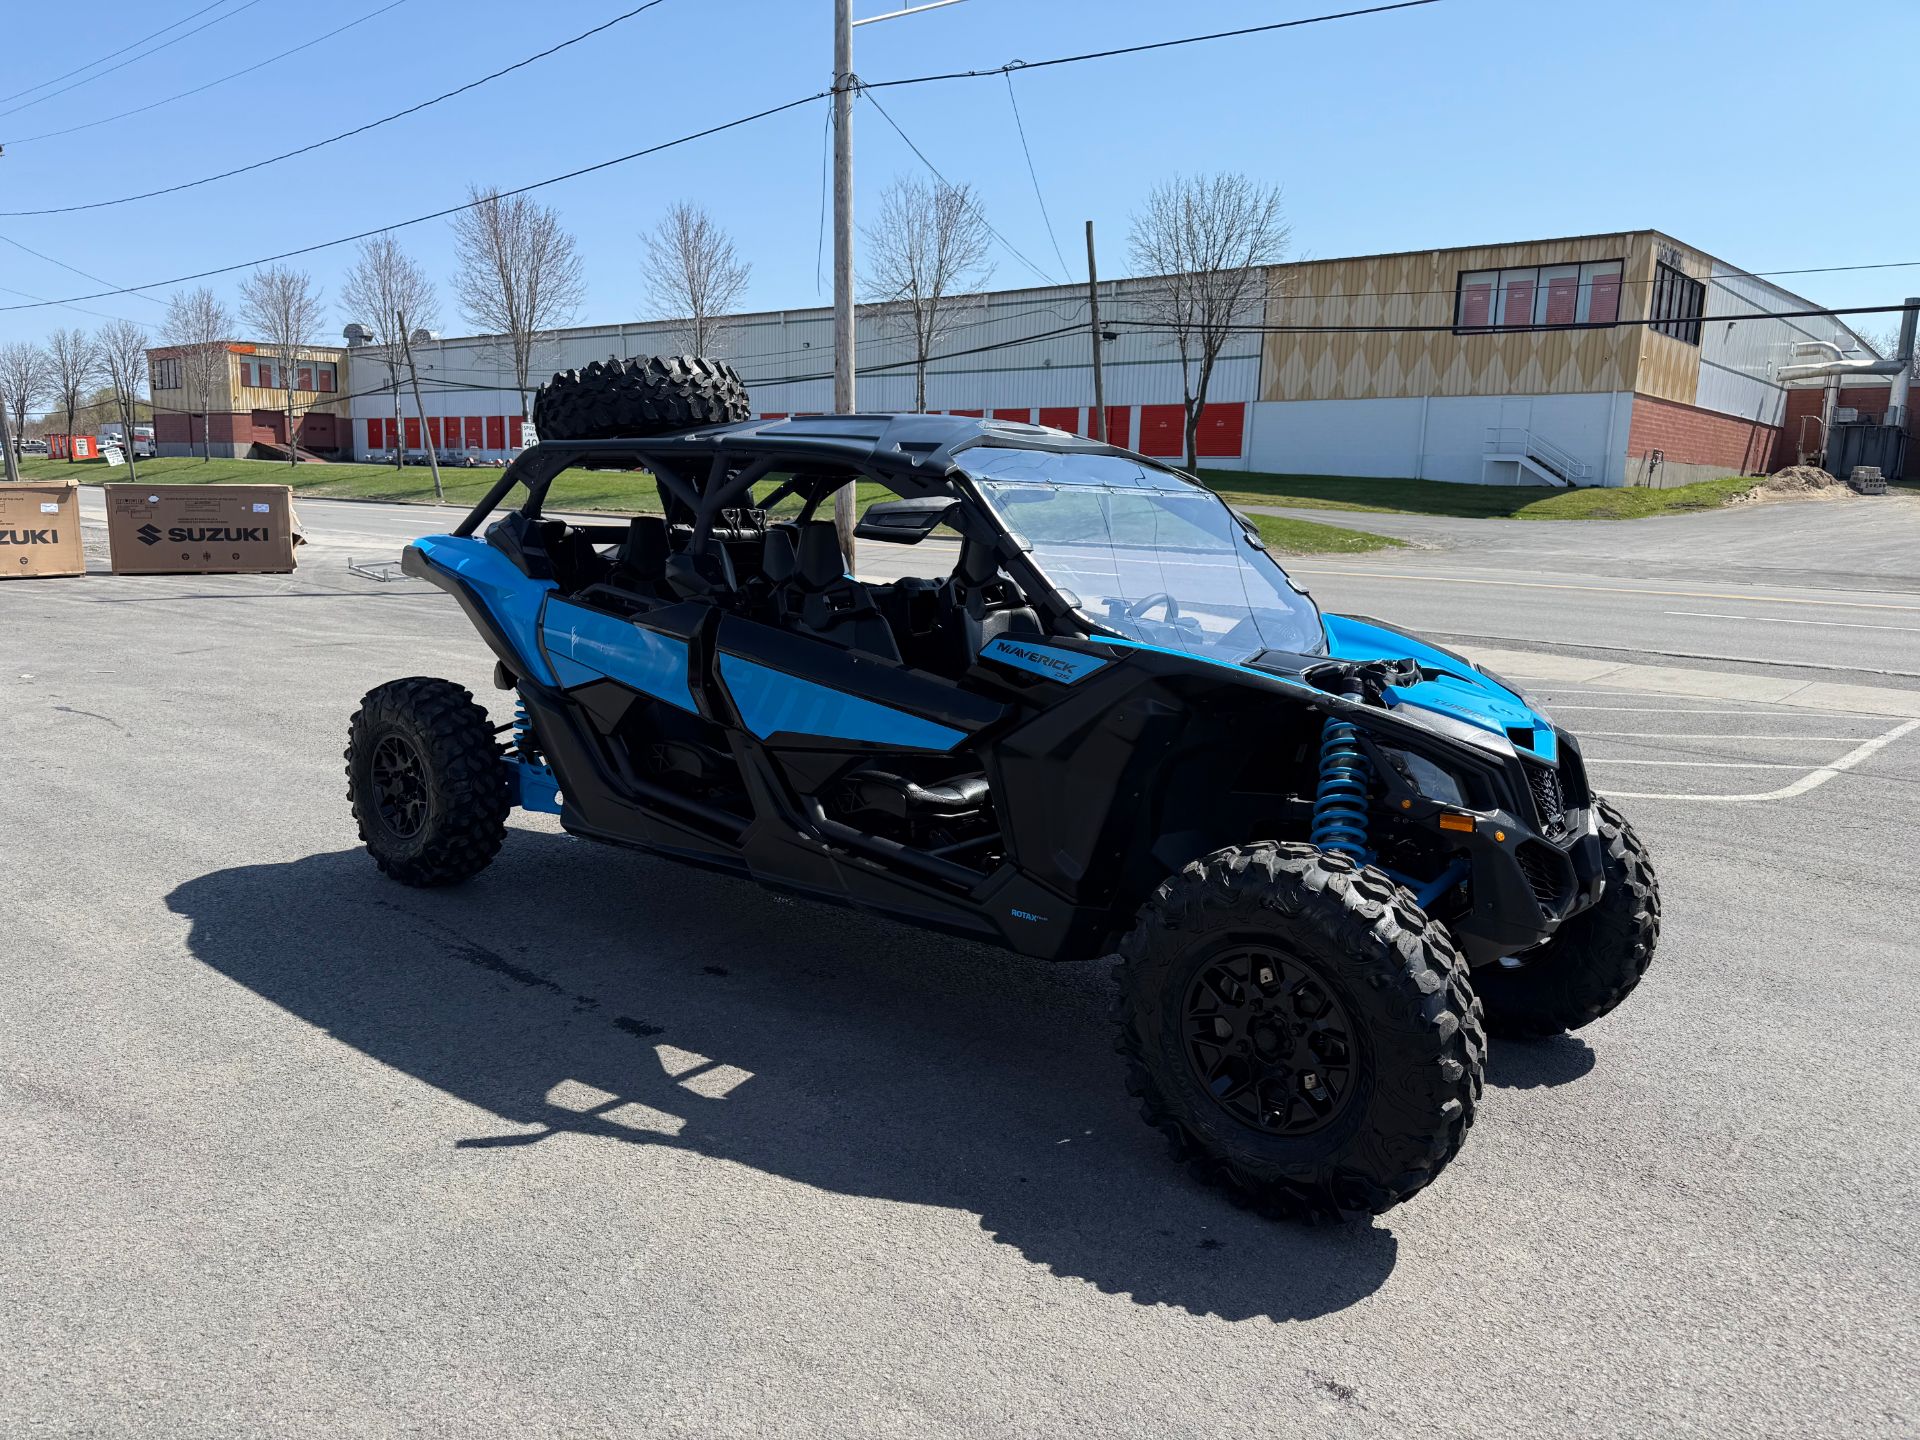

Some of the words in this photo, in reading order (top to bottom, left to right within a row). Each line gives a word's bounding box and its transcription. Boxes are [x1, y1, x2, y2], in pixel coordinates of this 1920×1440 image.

[524, 439, 538, 447] 40
[168, 527, 269, 542] SUZUKI
[996, 642, 1079, 674] MAVERICK
[1011, 909, 1037, 922] ROTAX
